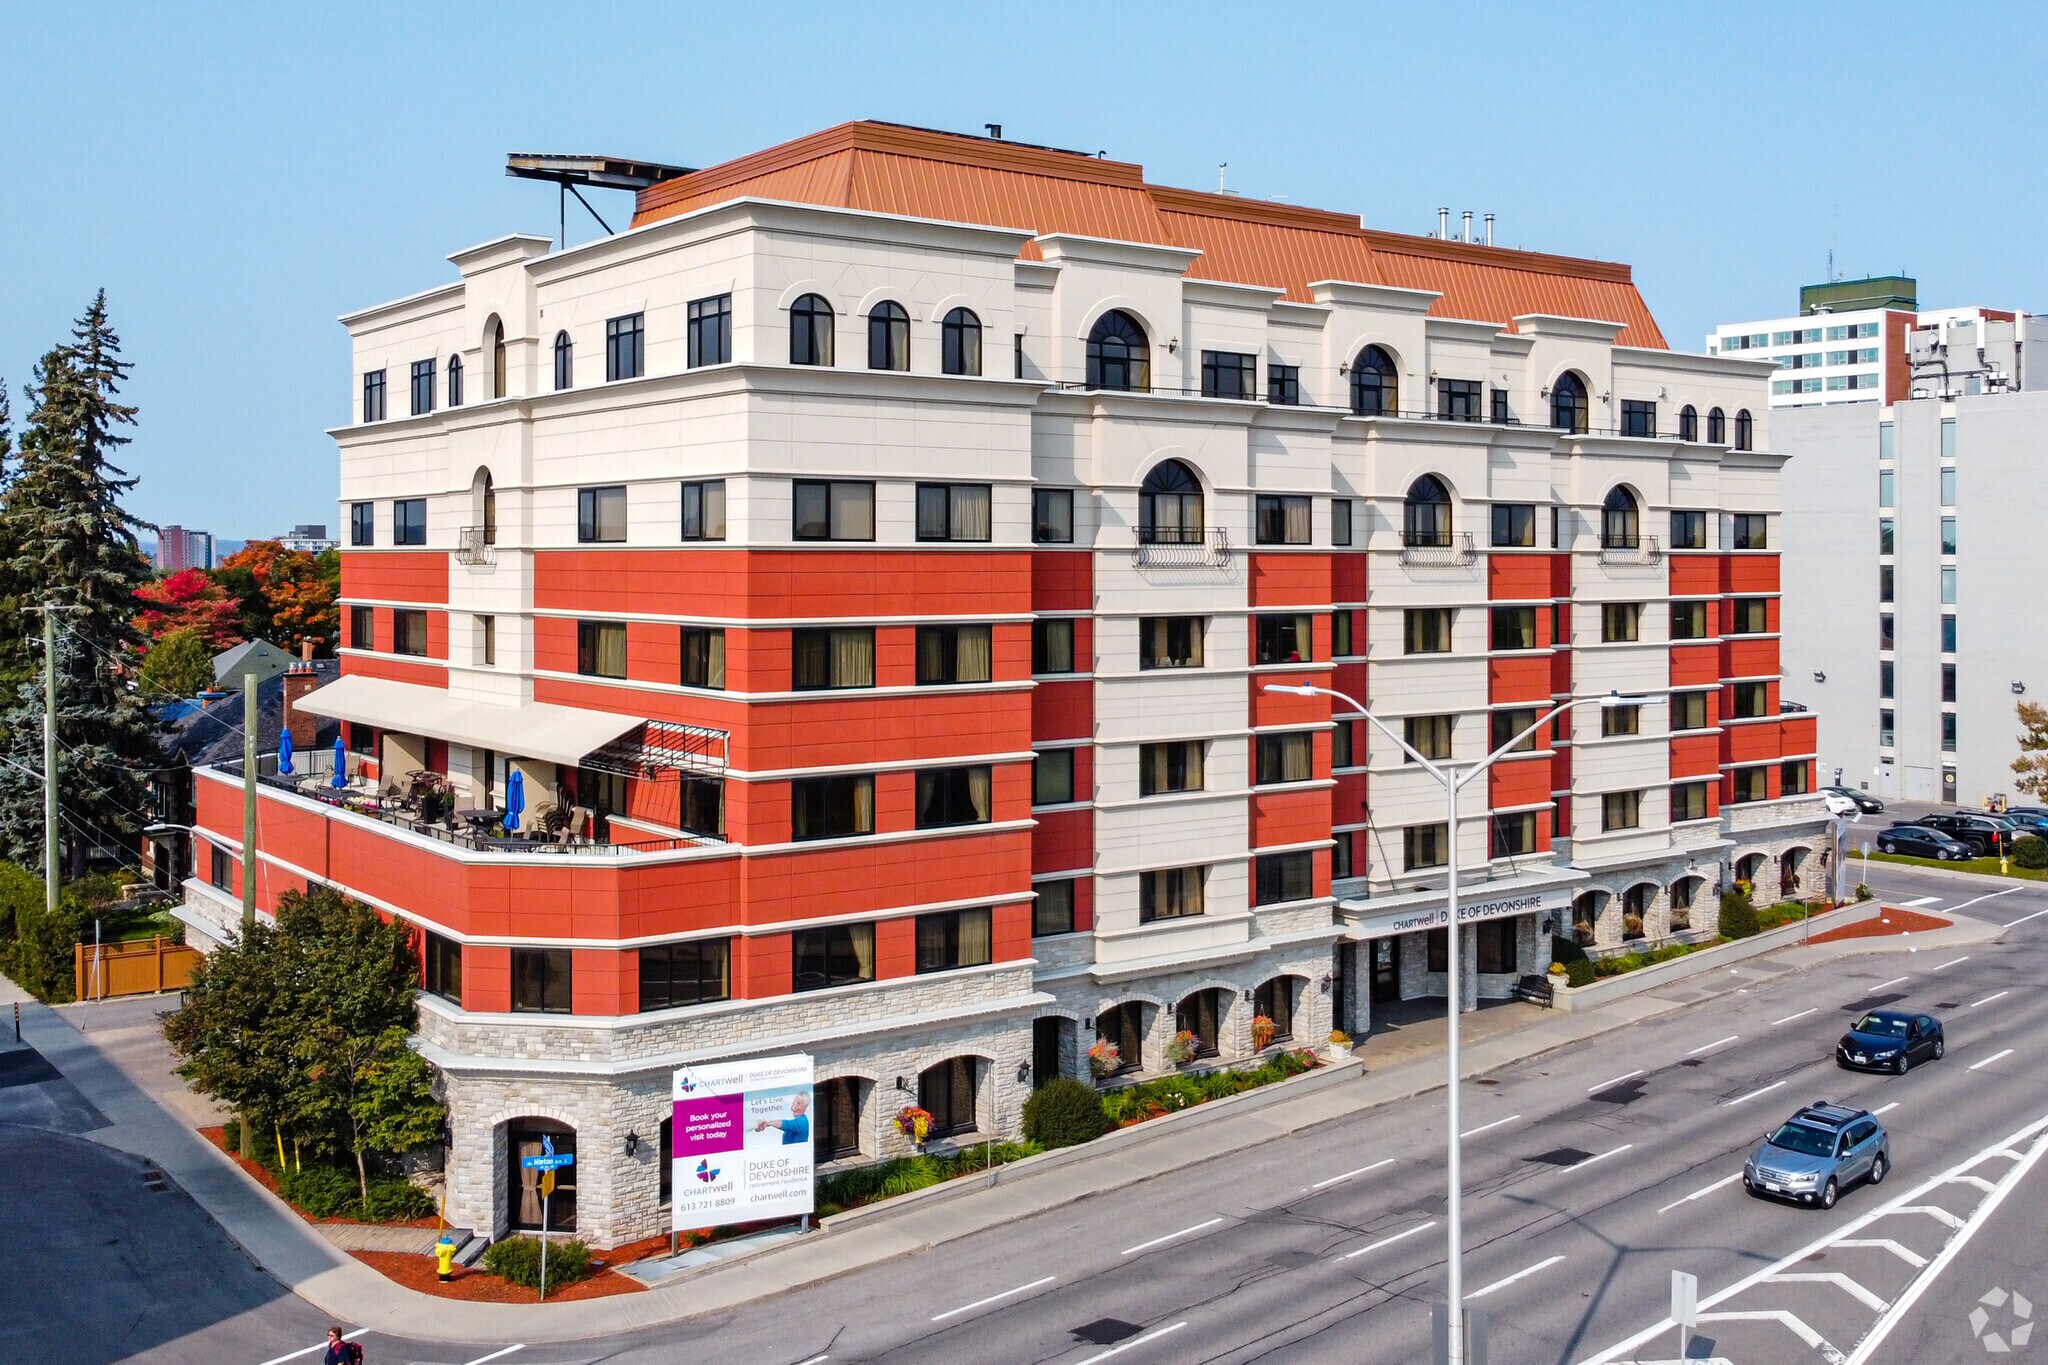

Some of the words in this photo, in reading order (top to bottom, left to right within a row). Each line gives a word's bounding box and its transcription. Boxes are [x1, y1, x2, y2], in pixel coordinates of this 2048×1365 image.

[1441, 908, 1466, 923] DKE
[1468, 905, 1481, 918] OF
[1483, 896, 1541, 916] DEVONSHIRE
[1393, 913, 1434, 931] CHARTwell
[699, 1074, 744, 1088] CHARTwell
[749, 1071, 764, 1079] DUKE
[750, 1097, 768, 1106] Let's
[689, 1114, 709, 1122] Book
[710, 1112, 728, 1120] your
[685, 1120, 732, 1133] personalized
[689, 1132, 705, 1141] visit
[706, 1131, 728, 1141] today
[749, 1160, 775, 1171] DUKE
[776, 1158, 790, 1168] OF
[749, 1165, 810, 1181] DEVONSHIRE
[683, 1181, 734, 1197] CHARTwell
[750, 1188, 807, 1203] chartwell.com
[680, 1202, 696, 1212] 613
[699, 1200, 712, 1209] 721
[714, 1197, 736, 1207] 8809
